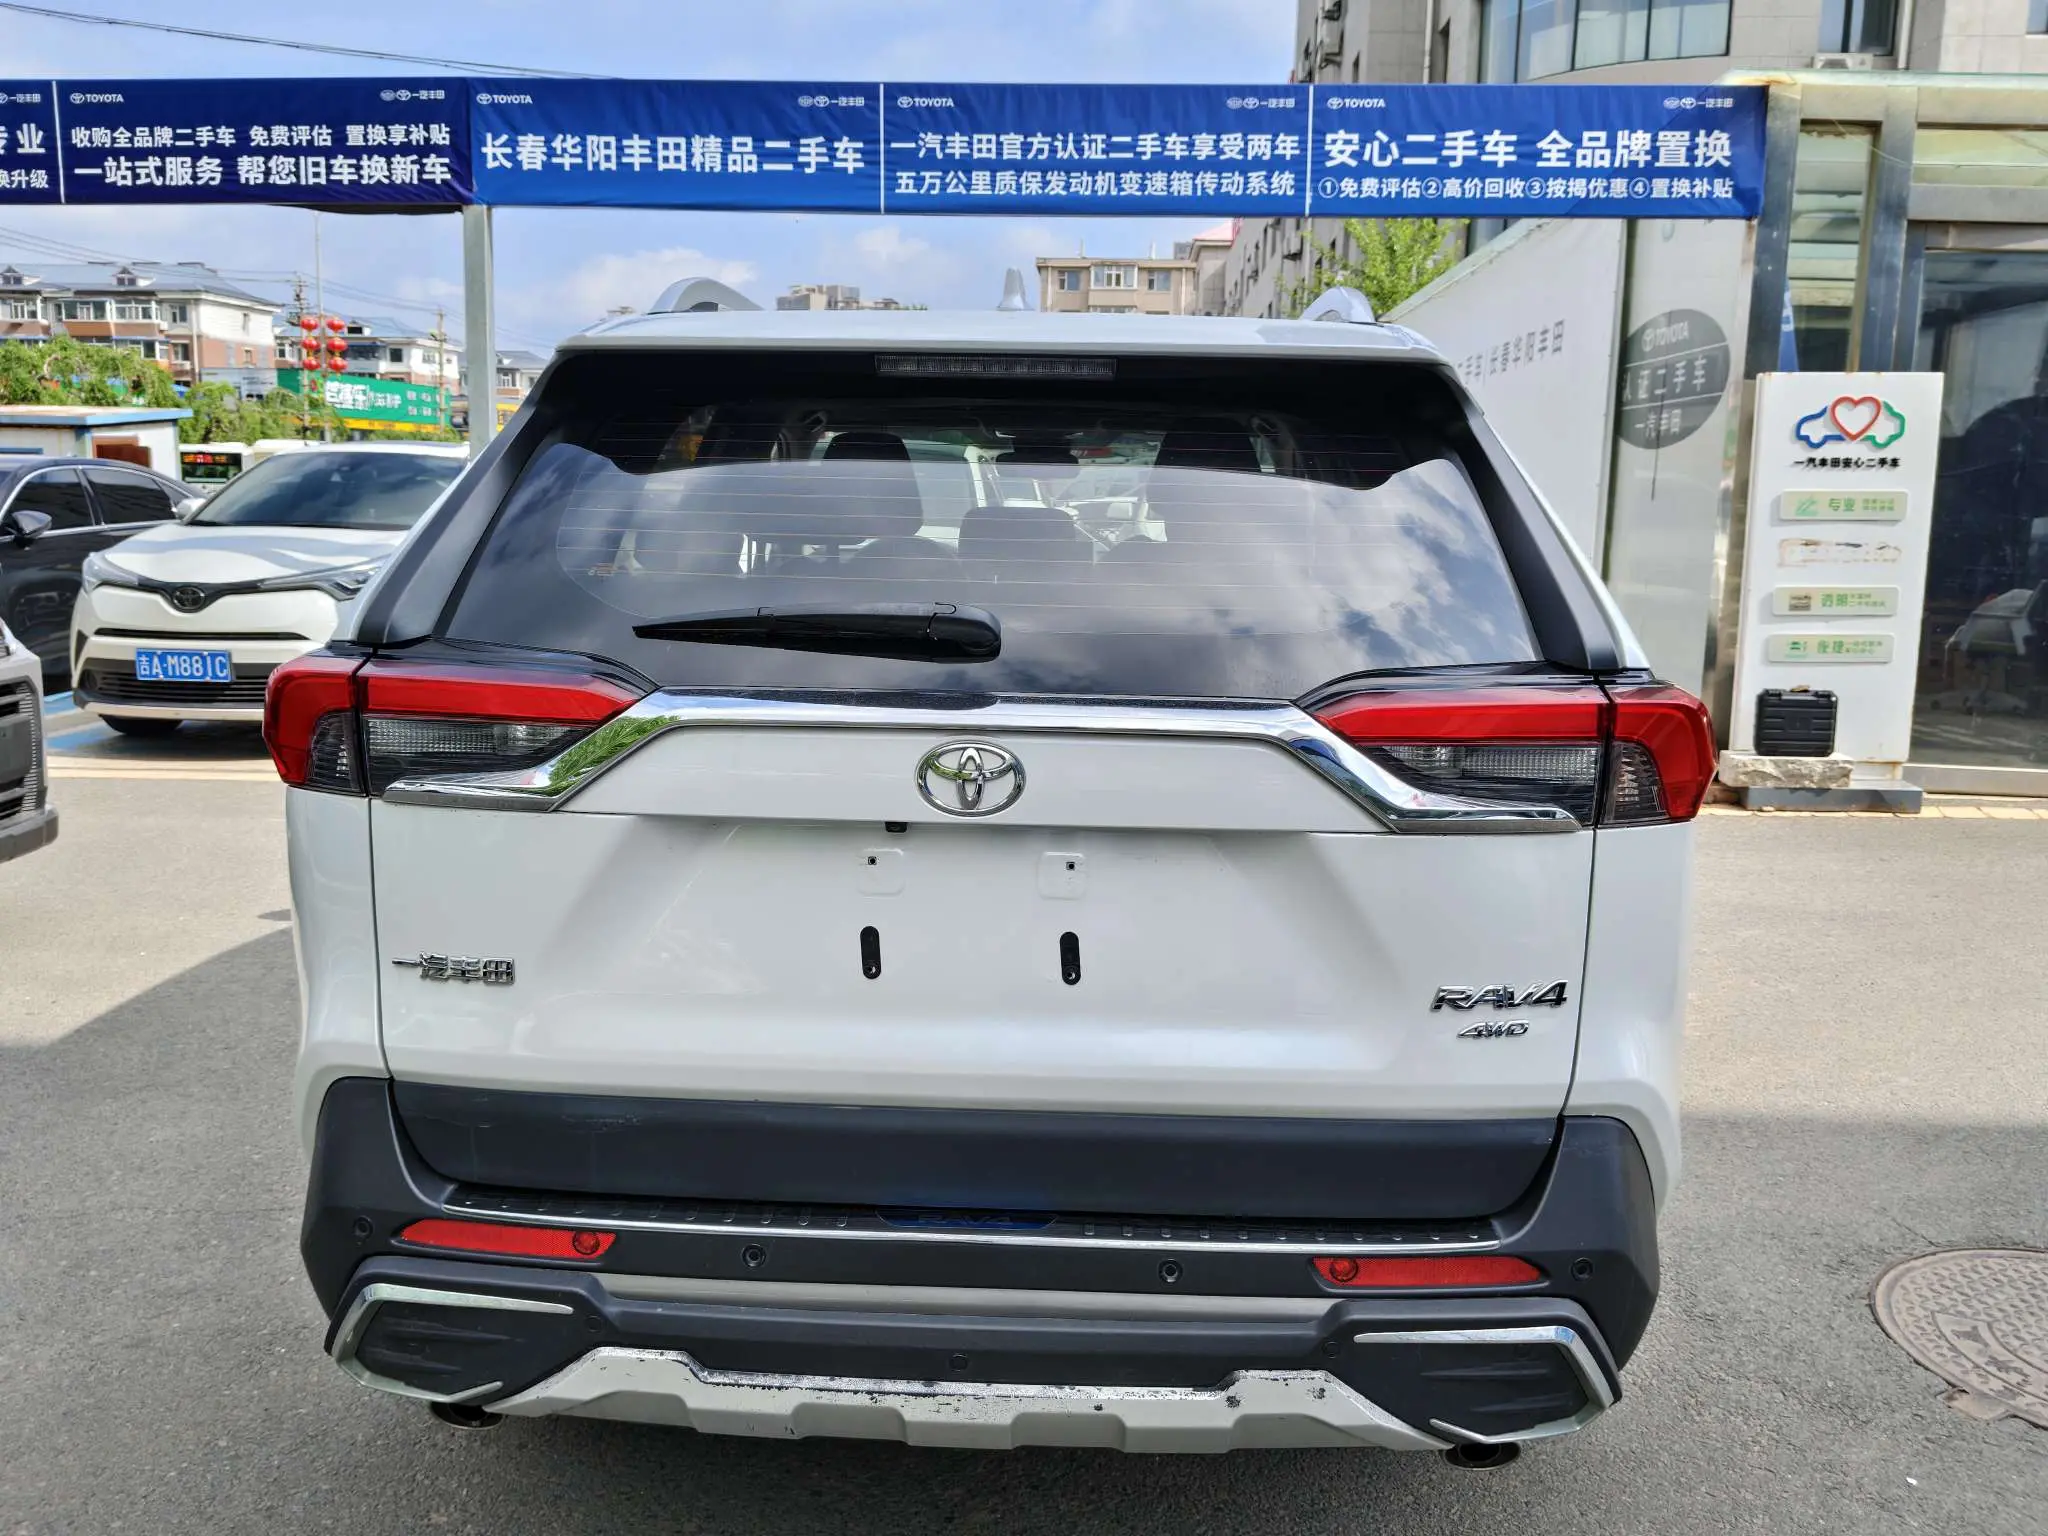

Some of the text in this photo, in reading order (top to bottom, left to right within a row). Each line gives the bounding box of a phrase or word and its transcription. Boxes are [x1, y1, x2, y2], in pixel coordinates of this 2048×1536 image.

[85, 93, 124, 103] TOYOTA
[493, 94, 533, 104] TOYOTA
[913, 97, 955, 108] TOYOTA
[1344, 98, 1386, 109] TOYOTA
[71, 123, 451, 148] 收购全品牌二手车 免费评估 置换享补贴
[889, 131, 1301, 161] 一汽丰田官方认证二手车享受两年
[481, 132, 865, 175] 长春华阳丰田精品二手车
[1324, 129, 1732, 169] 安心二手车 全品牌置换
[74, 153, 452, 187] 一站式服务 帮您旧车换新车
[893, 170, 1296, 197] 五万公里质保发动机变速箱传动系统
[1655, 321, 1689, 346] TOYOTA
[1634, 409, 1682, 439] 一汽丰田
[1794, 457, 1900, 469] 一汽丰田安心二手车
[1431, 978, 1568, 1011] RAV4
[1457, 1019, 1529, 1038] 4WD
